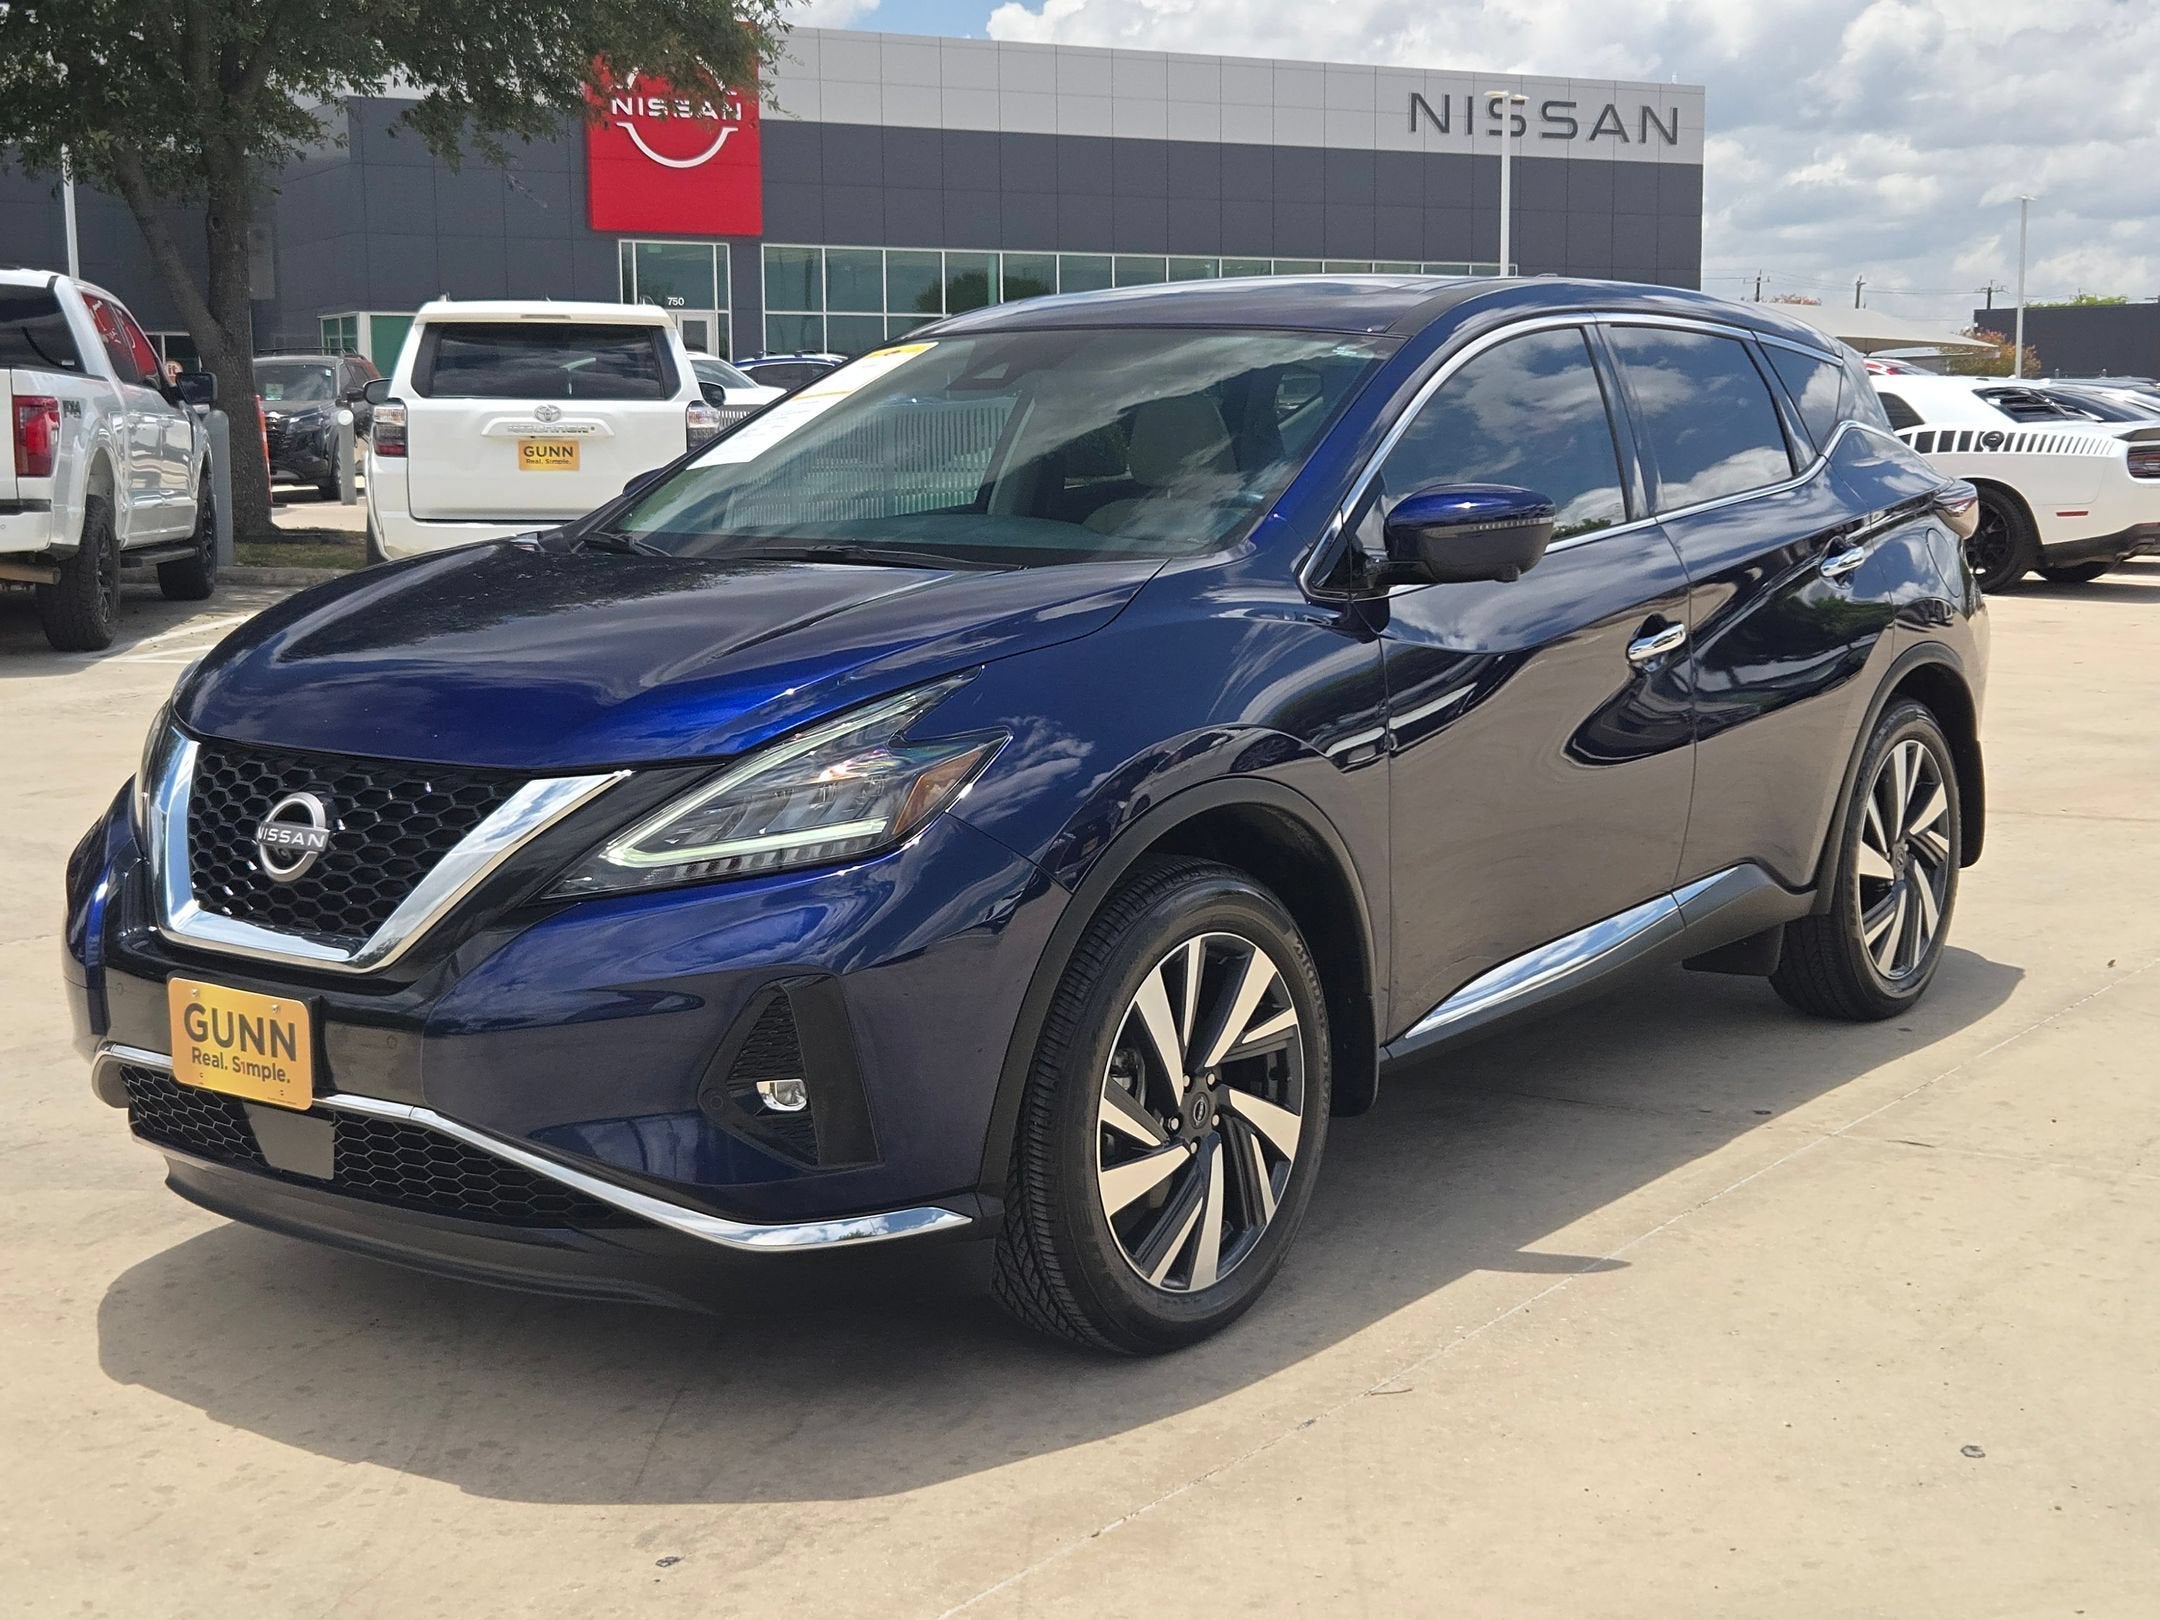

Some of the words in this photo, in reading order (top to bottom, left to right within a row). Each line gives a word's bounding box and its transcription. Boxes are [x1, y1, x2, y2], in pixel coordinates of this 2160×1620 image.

[1409, 91, 1679, 145] NISSAN
[667, 297, 685, 306] 750
[524, 446, 574, 457] GUNN
[257, 826, 326, 848] NISSAN
[184, 1003, 297, 1062] GUNN
[191, 1047, 228, 1071] Real.
